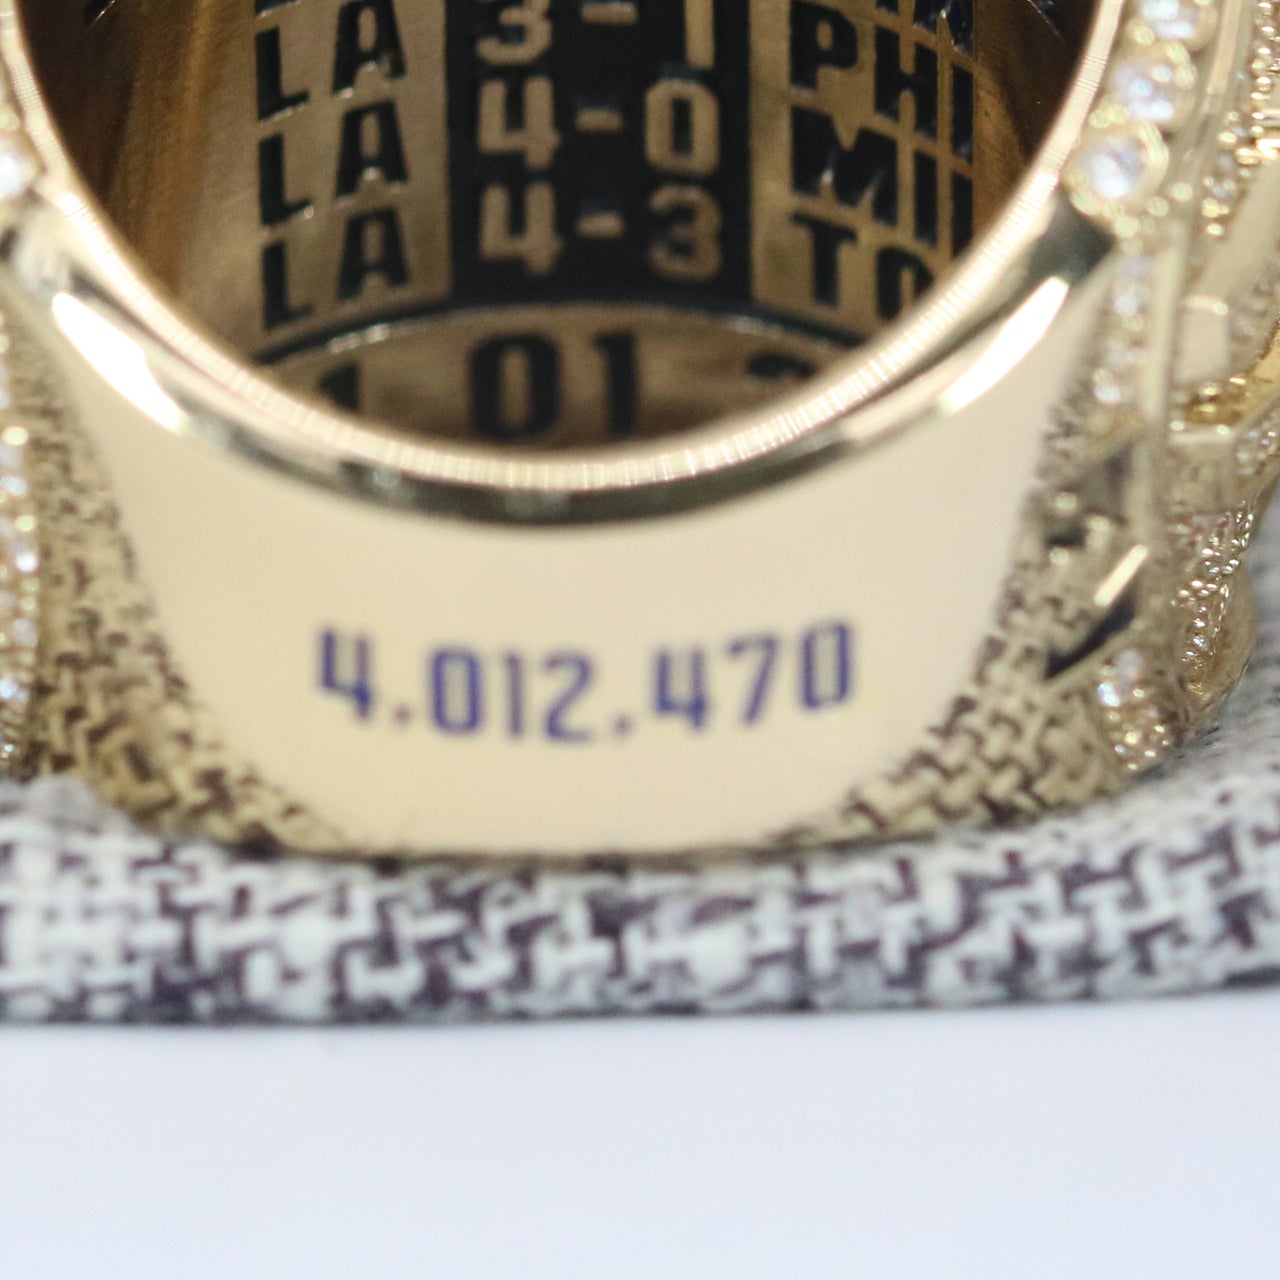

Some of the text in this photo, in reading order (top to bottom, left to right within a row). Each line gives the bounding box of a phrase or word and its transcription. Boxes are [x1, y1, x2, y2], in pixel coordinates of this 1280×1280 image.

[258, 100, 410, 227] LA
[478, 76, 720, 177] 4-0
[262, 208, 412, 329] LA
[479, 182, 722, 281] 4-3
[317, 618, 855, 744] 4.012.470
